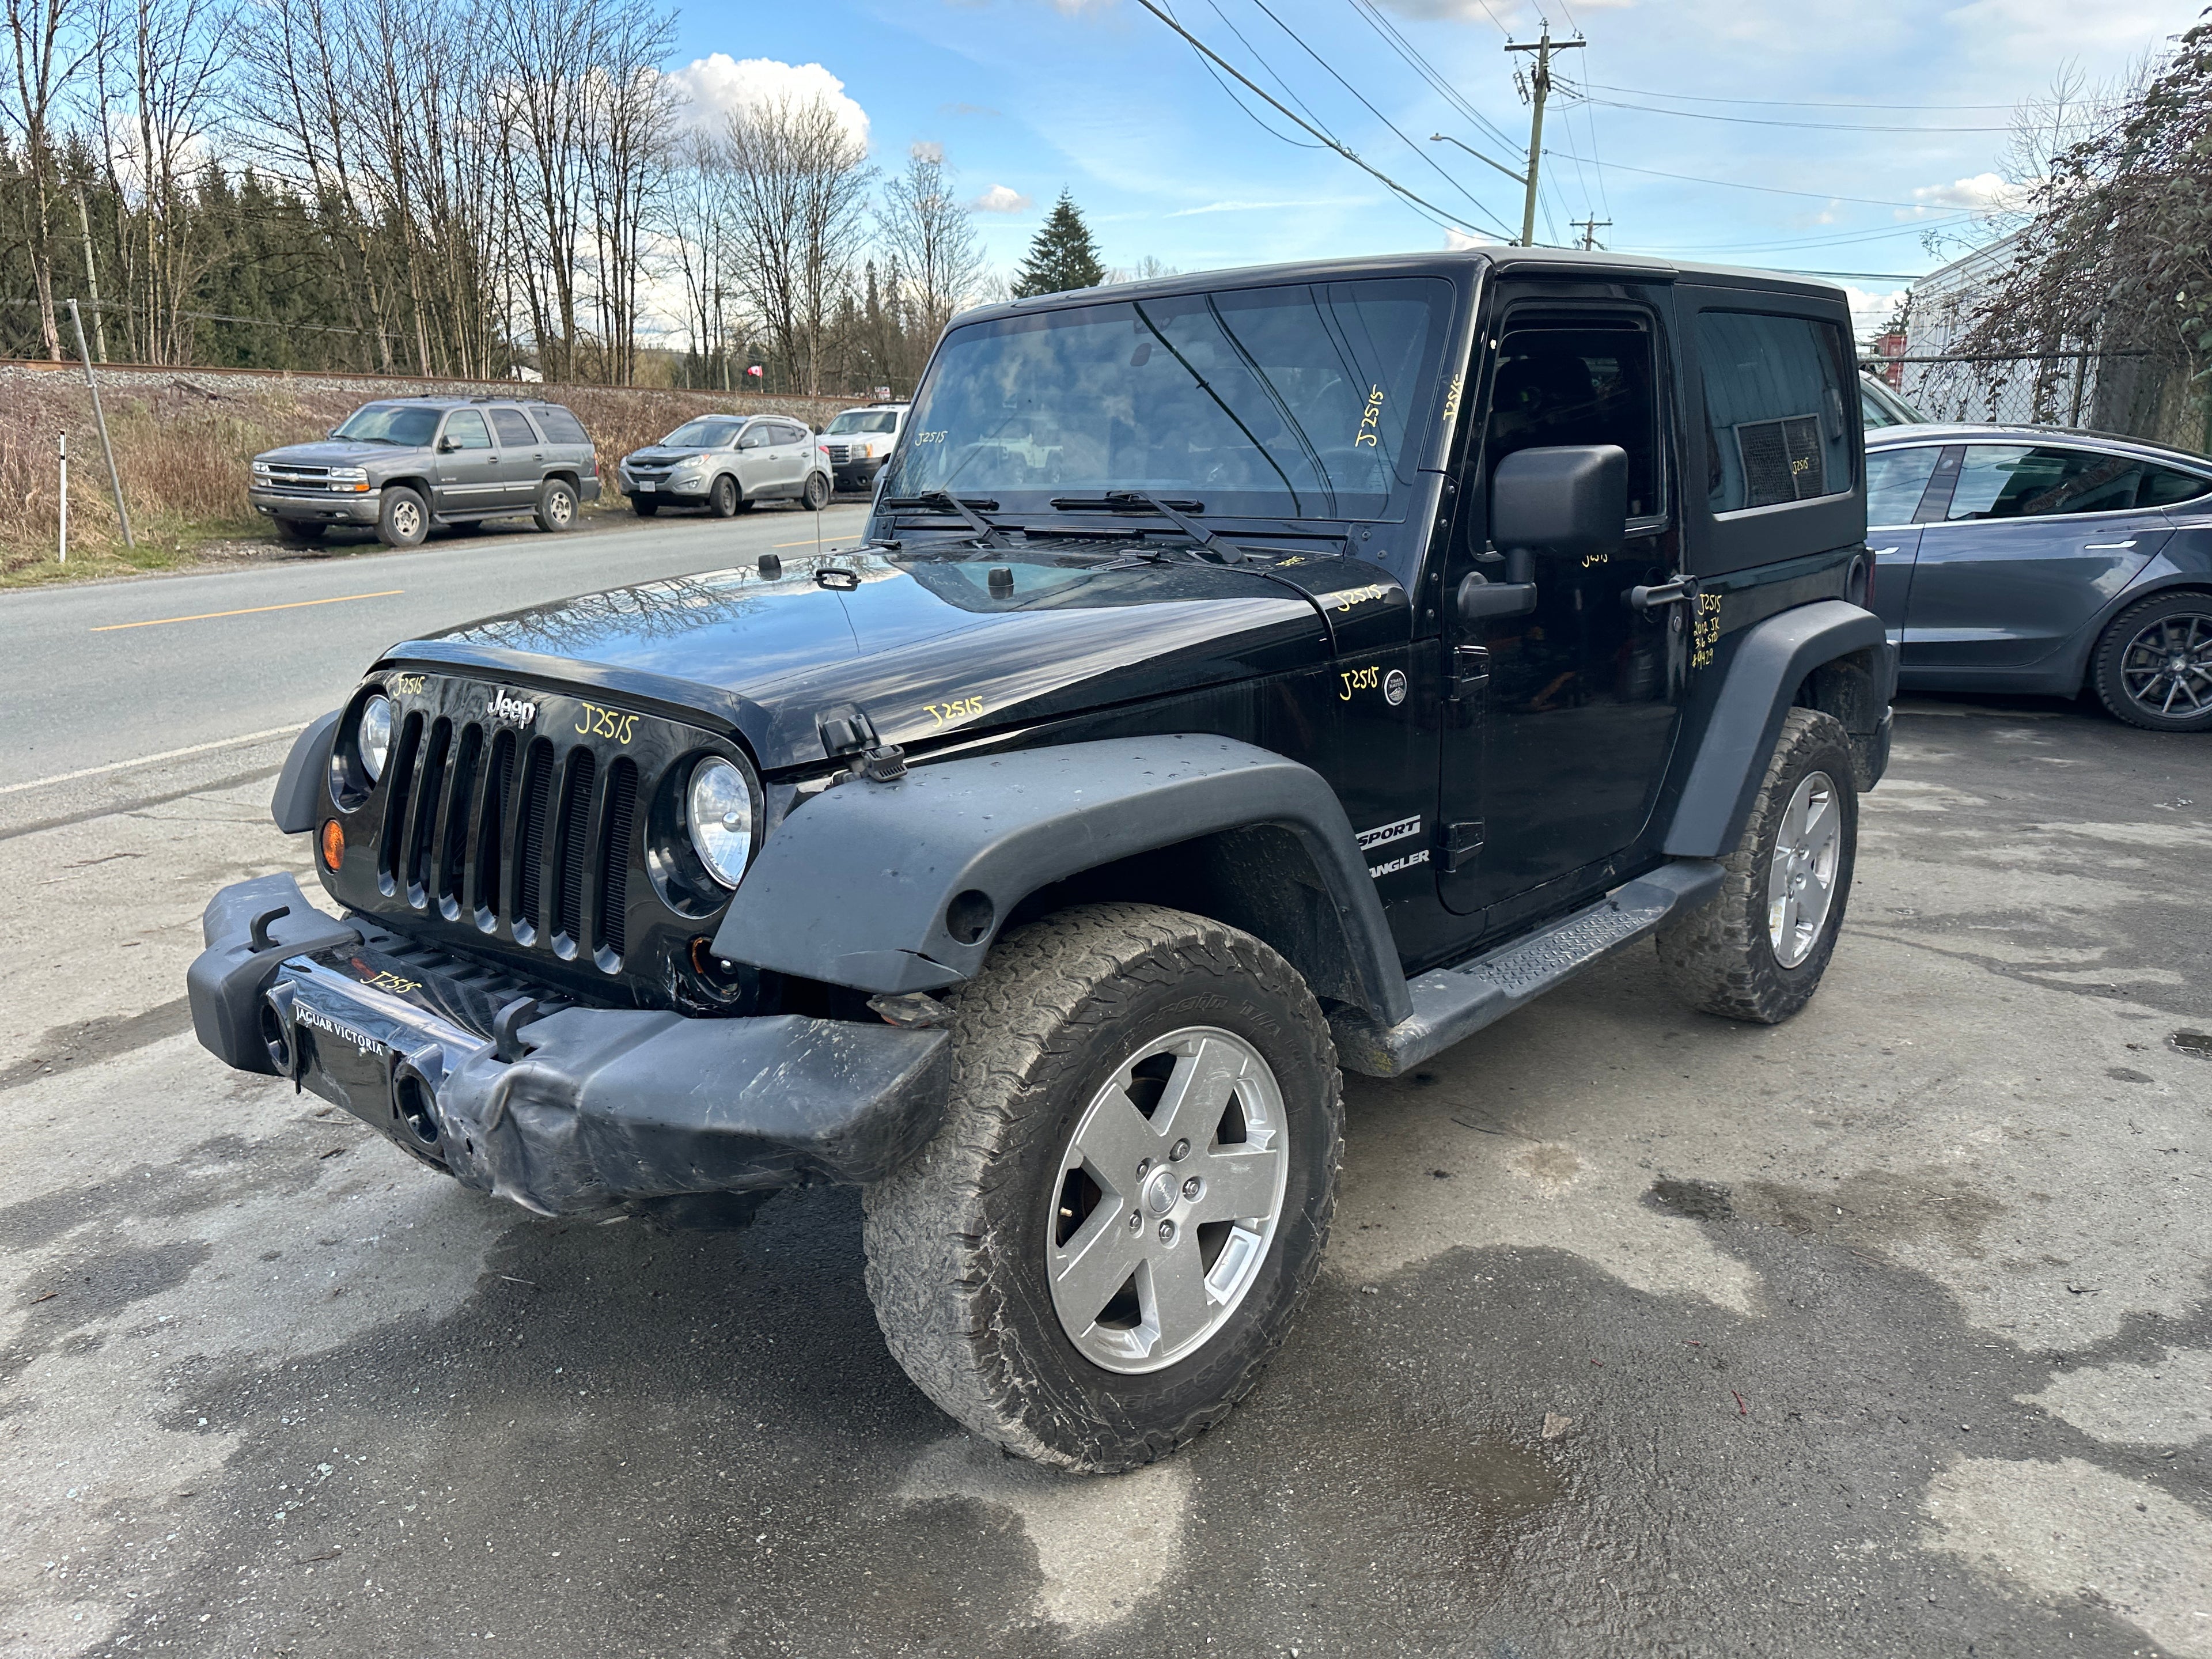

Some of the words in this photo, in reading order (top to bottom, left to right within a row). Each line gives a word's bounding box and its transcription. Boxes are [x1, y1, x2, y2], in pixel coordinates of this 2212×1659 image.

[1443, 373, 1463, 423] J2515
[1355, 384, 1384, 447] J2515
[915, 430, 948, 446] J2515
[1793, 457, 1809, 475] J2515
[1330, 584, 1382, 612] J2515
[1697, 593, 1722, 616] J2515
[1693, 620, 1709, 636] 2012
[1710, 616, 1720, 631] JK
[1707, 631, 1718, 643] STD
[393, 676, 425, 697] J2515
[1339, 666, 1379, 700] J2515
[487, 690, 536, 729] Jeep
[575, 702, 639, 744] J2515
[923, 695, 983, 728] J2515
[1358, 819, 1421, 847] SPORT
[1369, 849, 1430, 878] ANGLER
[359, 971, 422, 993] J2515
[296, 1006, 333, 1033] JAGUAR
[334, 1024, 383, 1056] VICTORIA
